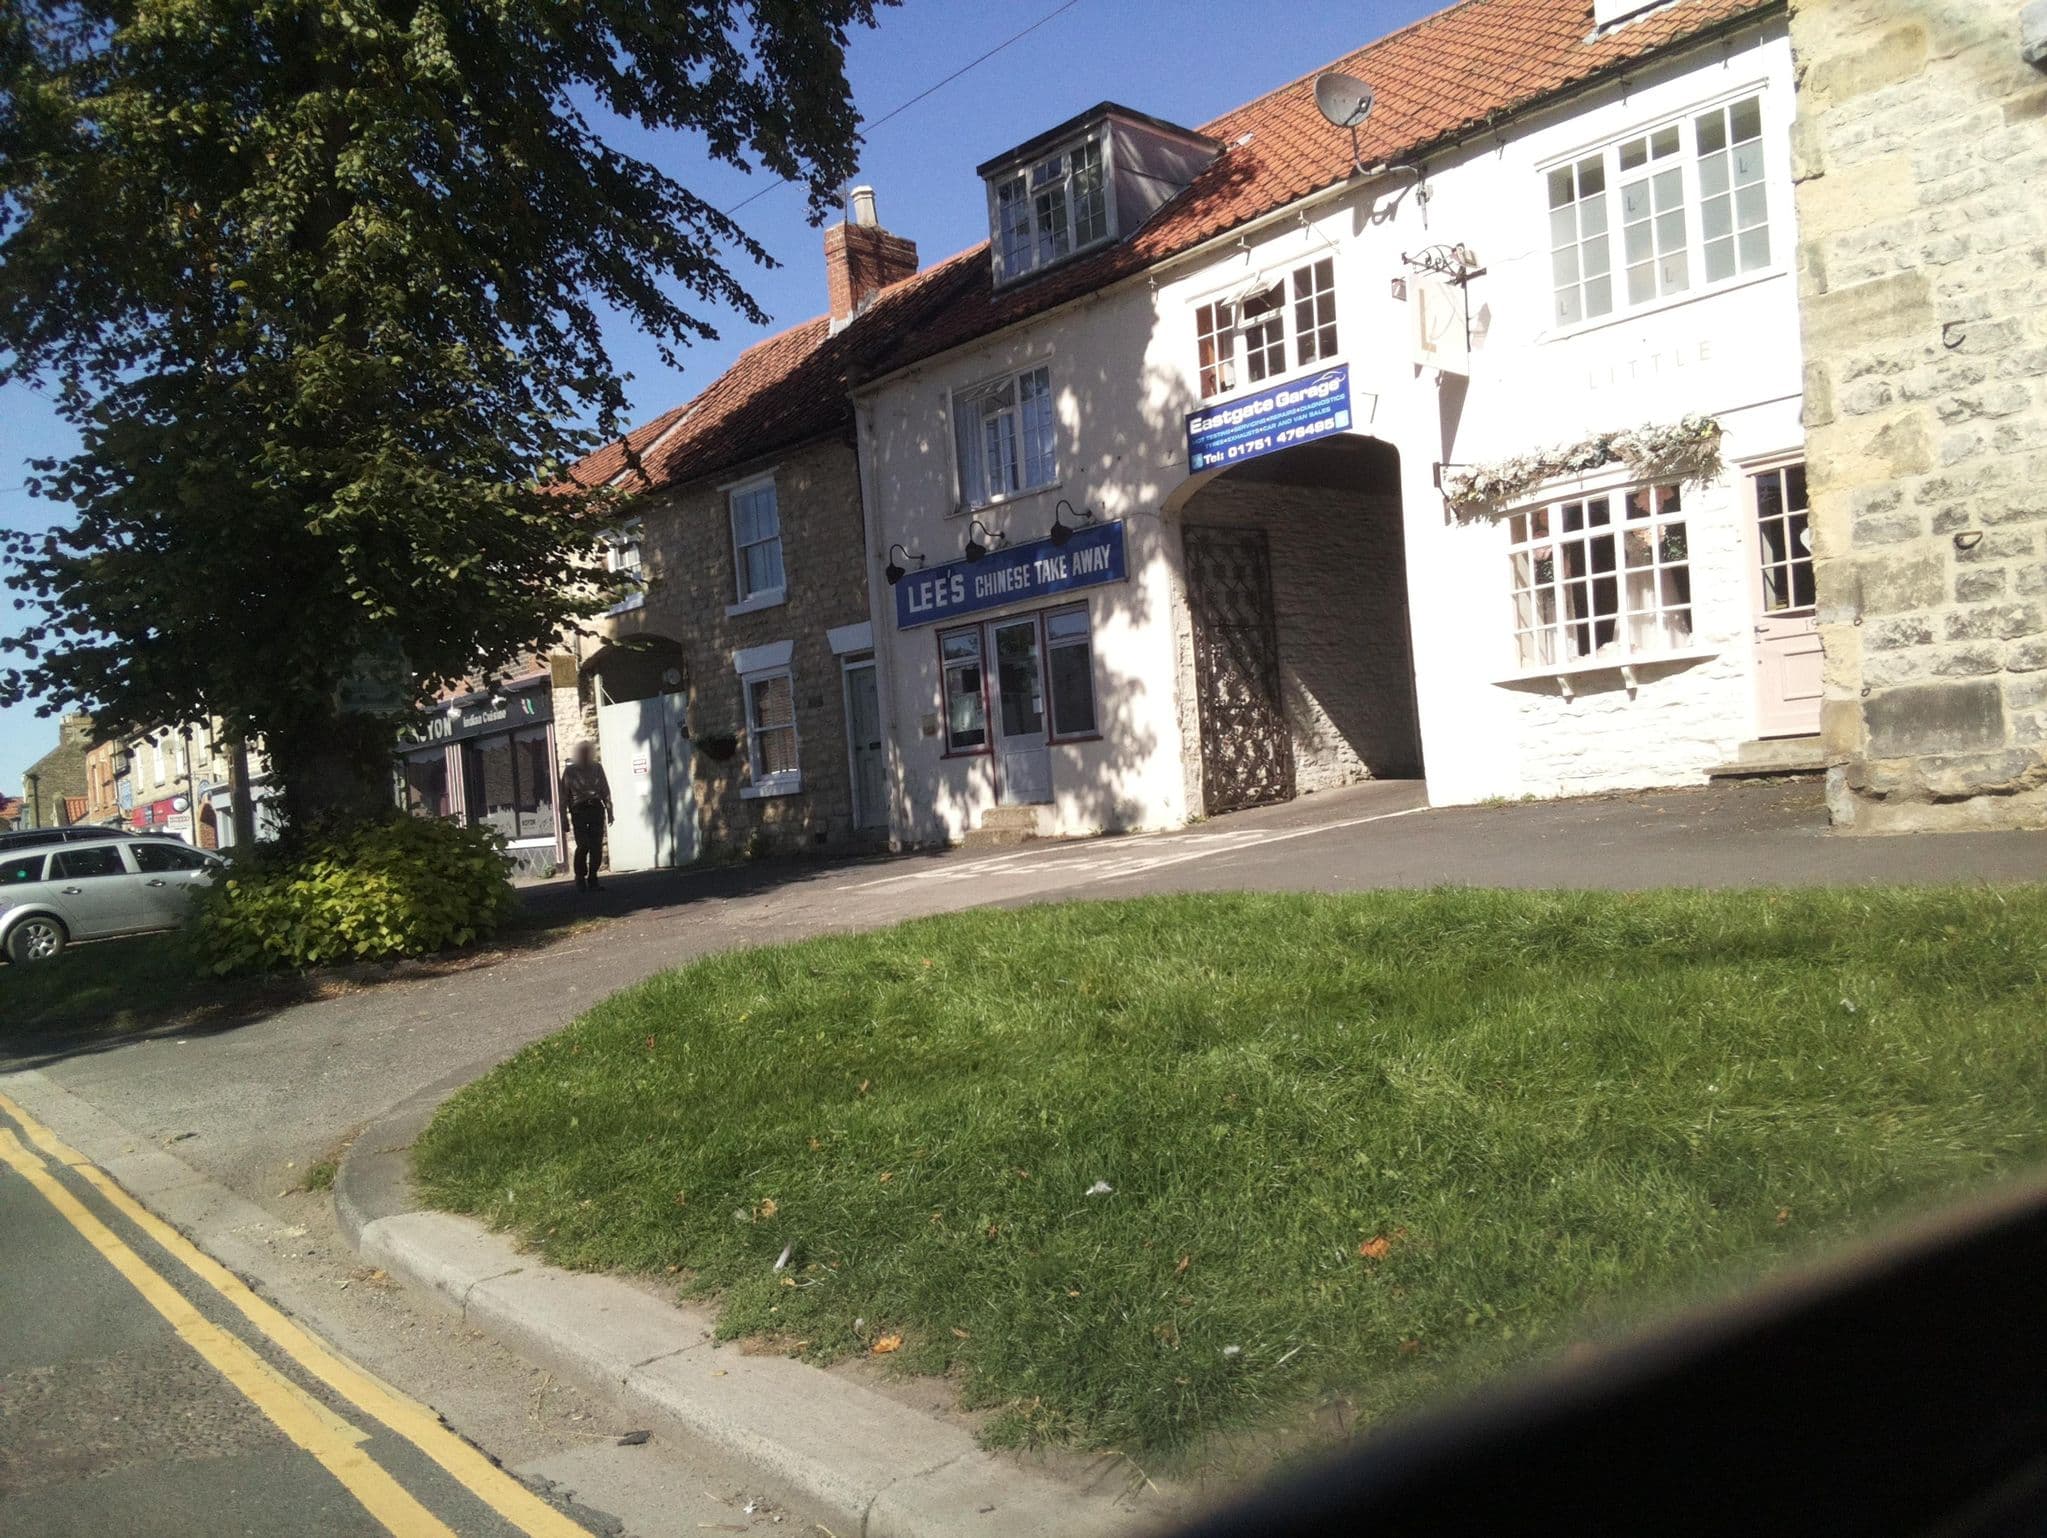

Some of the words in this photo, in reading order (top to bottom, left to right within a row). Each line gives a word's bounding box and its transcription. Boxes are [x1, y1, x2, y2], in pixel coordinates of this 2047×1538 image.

[1589, 340, 1711, 390] LITTLE
[1189, 399, 1275, 434] Eastgate
[1276, 378, 1341, 408] Garage
[1205, 428, 1231, 442] TESTING
[1299, 393, 1346, 412] DIAGNOSTICS
[1228, 429, 1260, 442] EXHAUSTS
[1263, 422, 1277, 432] CAR
[1277, 417, 1293, 428] AND
[1294, 412, 1308, 423] VAN
[1309, 406, 1331, 418] SALES
[1203, 450, 1225, 465] Tel:
[1228, 436, 1272, 458] 01751
[908, 569, 964, 613] LEE'S
[975, 563, 1031, 599] CHINESE
[1034, 555, 1067, 585] TAKE
[1072, 544, 1111, 576] AWAY
[463, 714, 482, 728] Indian
[483, 709, 507, 722] Cuisine
